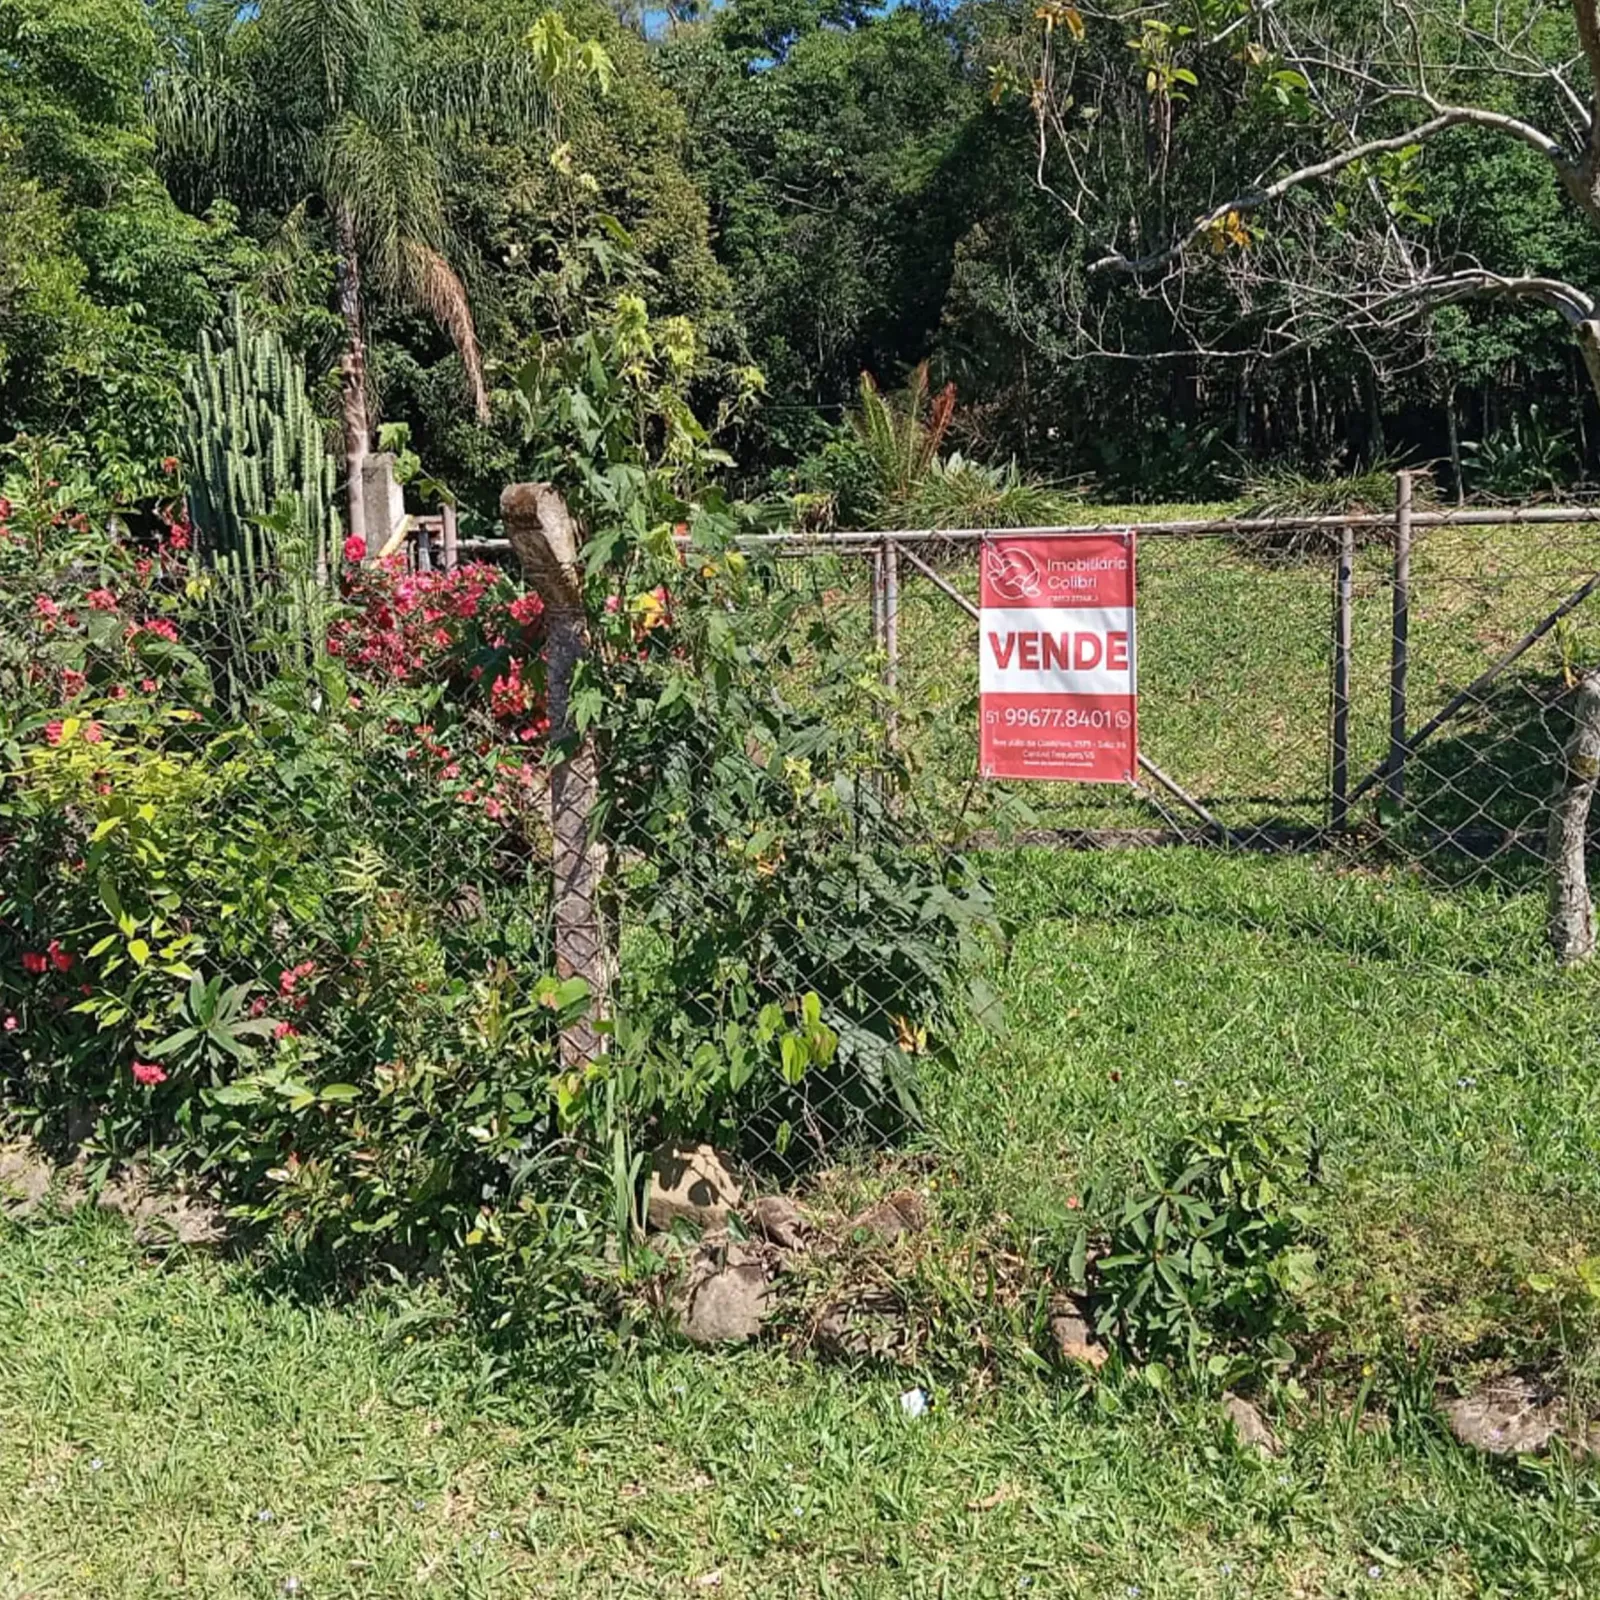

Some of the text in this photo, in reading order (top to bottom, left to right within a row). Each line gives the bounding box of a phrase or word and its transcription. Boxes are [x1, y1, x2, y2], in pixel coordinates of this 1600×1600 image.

[1047, 575, 1097, 590] Colibri
[987, 631, 1129, 671] VENDE
[985, 708, 1112, 729] 51 99677.8401
